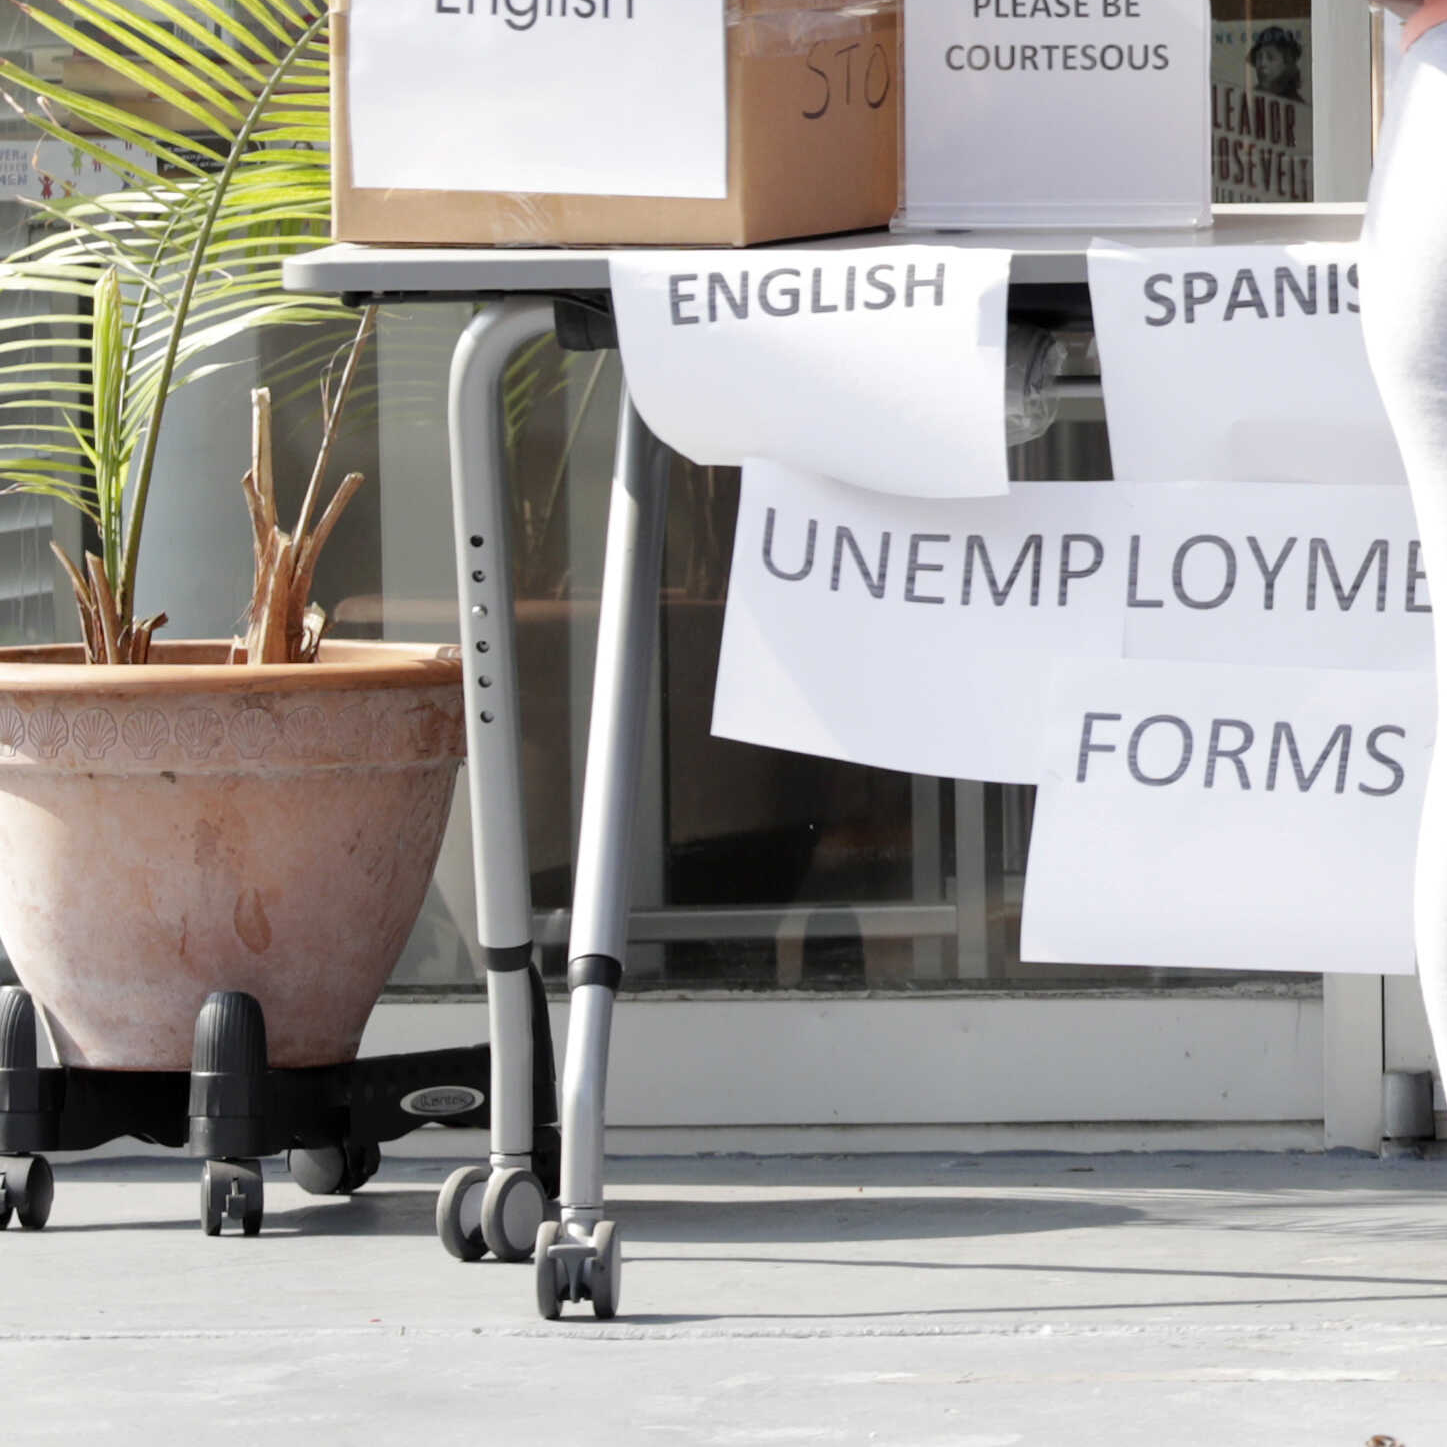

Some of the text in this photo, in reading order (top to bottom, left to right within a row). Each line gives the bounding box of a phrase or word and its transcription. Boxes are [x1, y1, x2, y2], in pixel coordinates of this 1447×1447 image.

[802, 40, 890, 121] STO
[945, 44, 1169, 72] COURTESOUS
[1212, 84, 1296, 148] LEANOR
[668, 262, 947, 327] ENGLISH
[1144, 262, 1362, 329] SPANI
[762, 505, 1433, 614] UNEMPLOYME
[1076, 711, 1406, 798] FORMS
